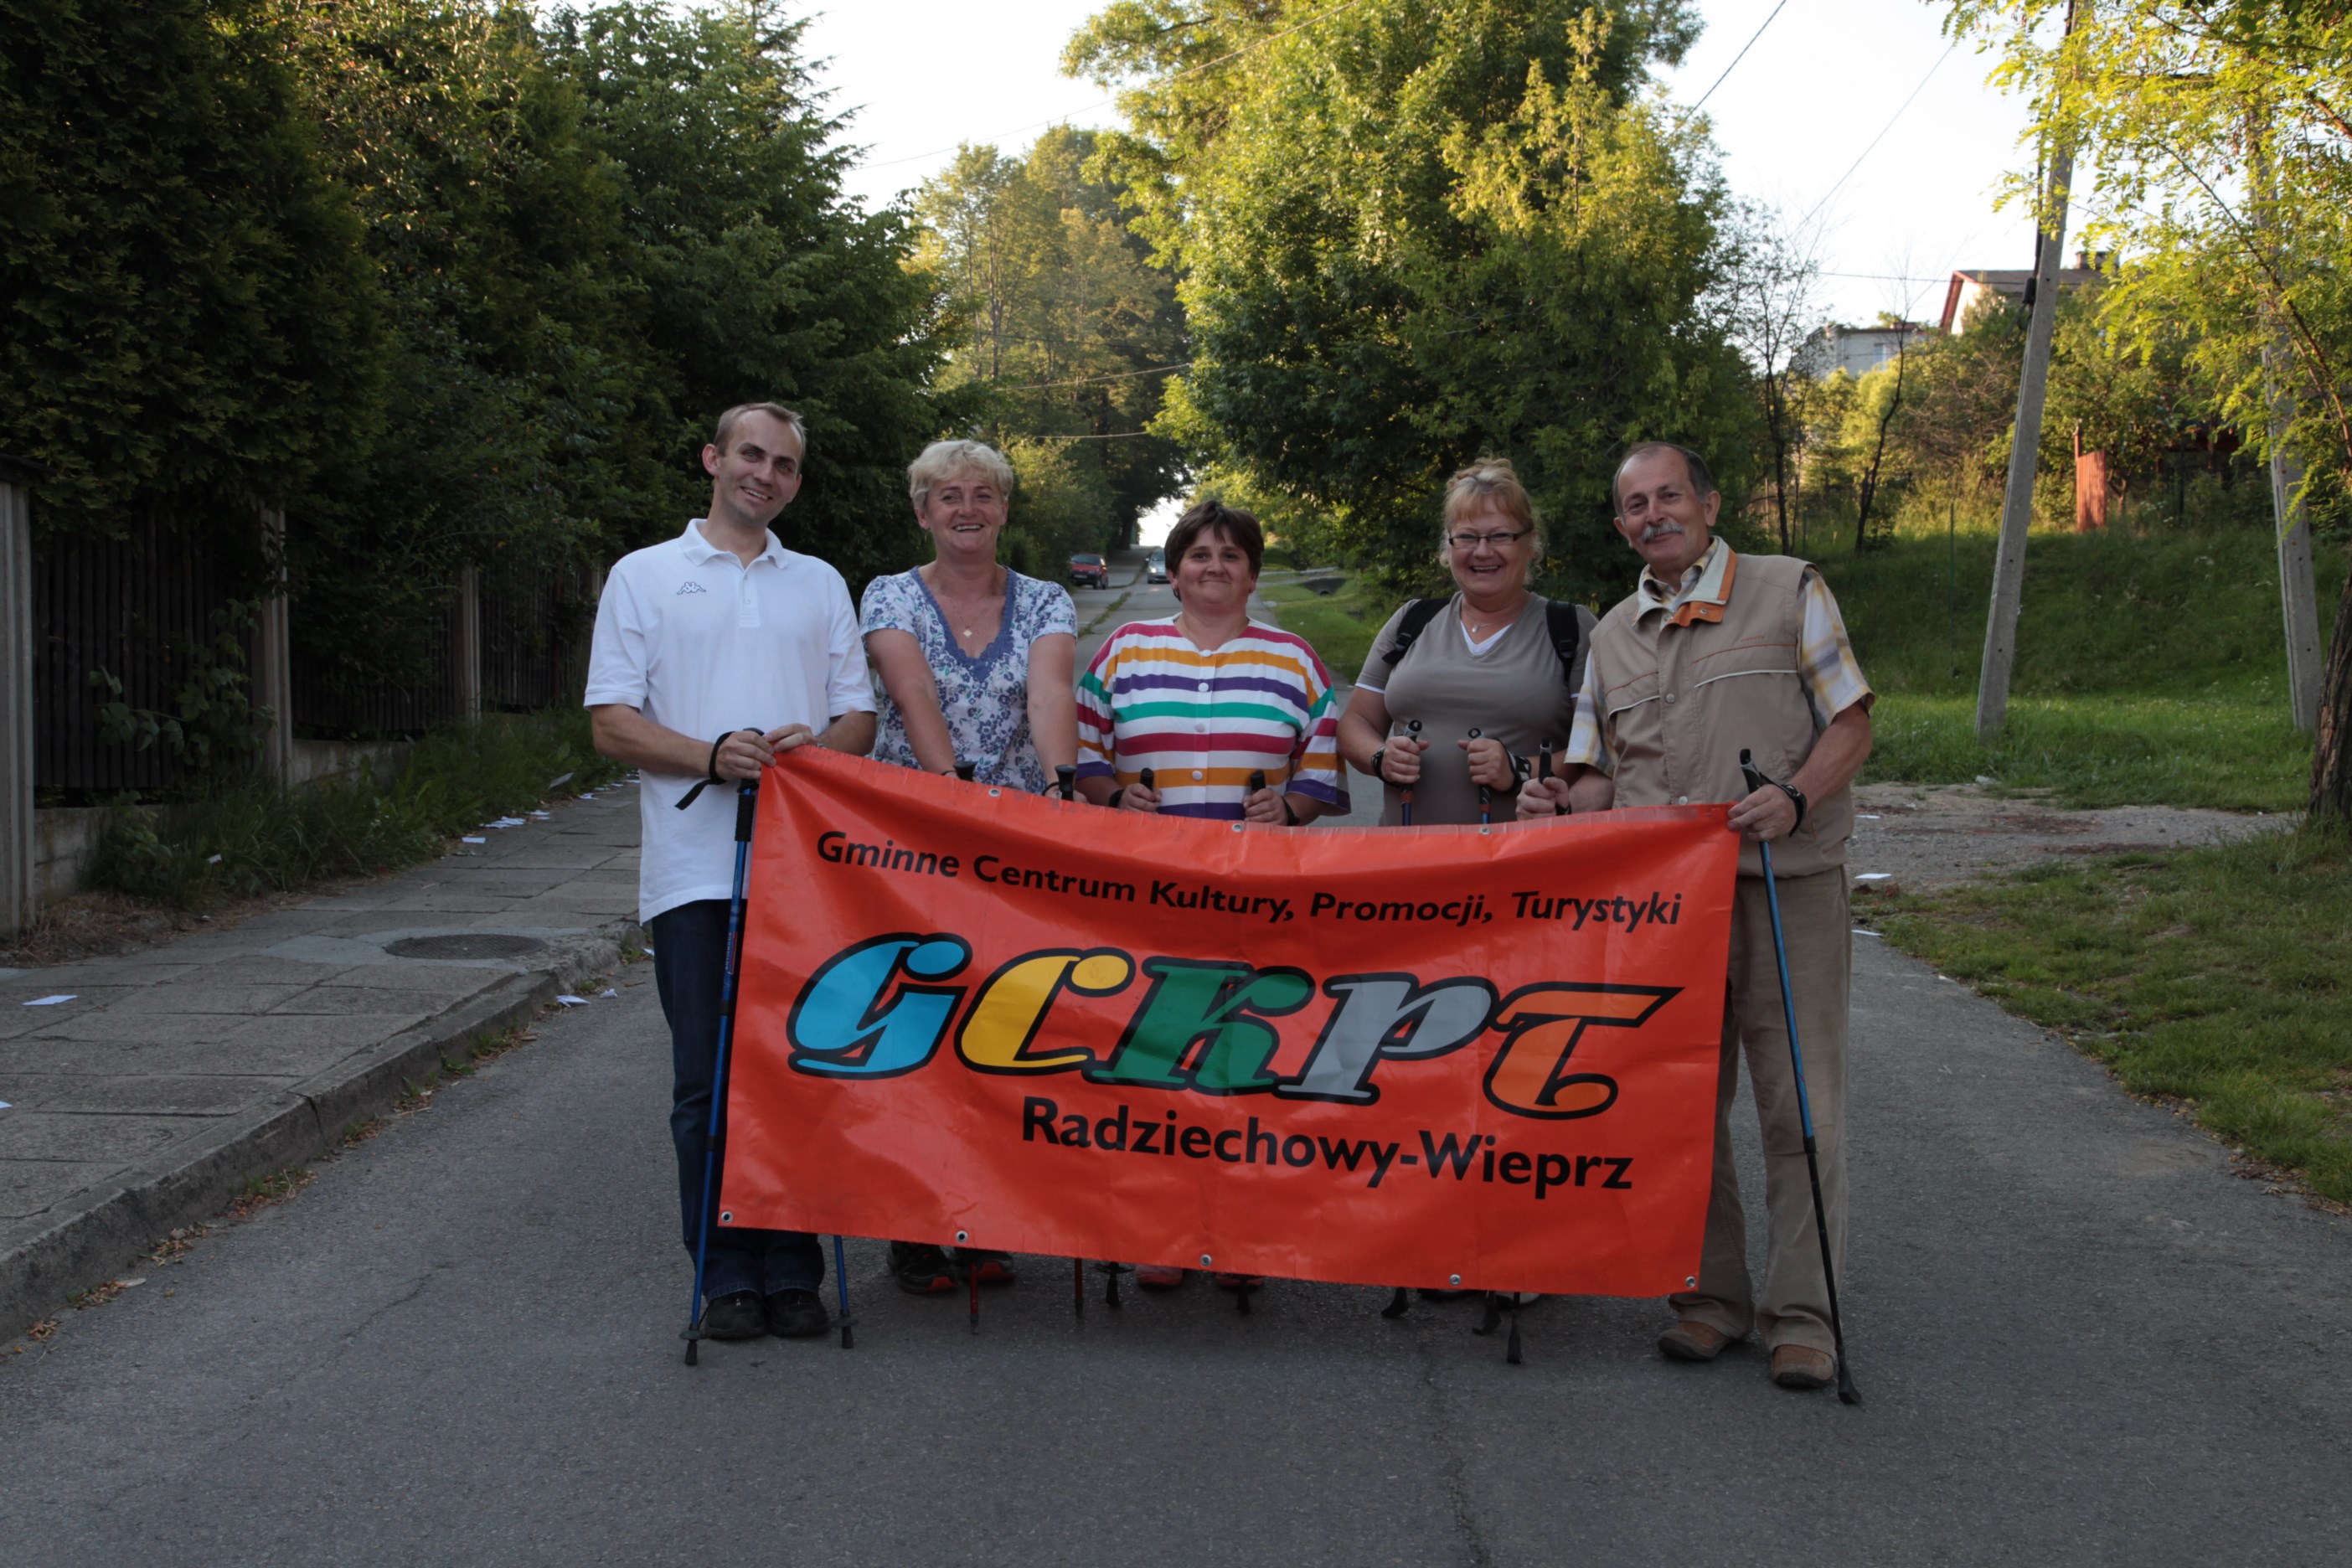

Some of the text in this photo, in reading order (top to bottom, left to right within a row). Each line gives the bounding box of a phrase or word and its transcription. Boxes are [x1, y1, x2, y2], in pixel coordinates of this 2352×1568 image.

[816, 830, 1683, 933] Gminne Centrum Kultury, Promocji, Turystyki
[785, 931, 1685, 1121] GCKPT
[1022, 1096, 1634, 1200] Radziechowy-Wieprz
